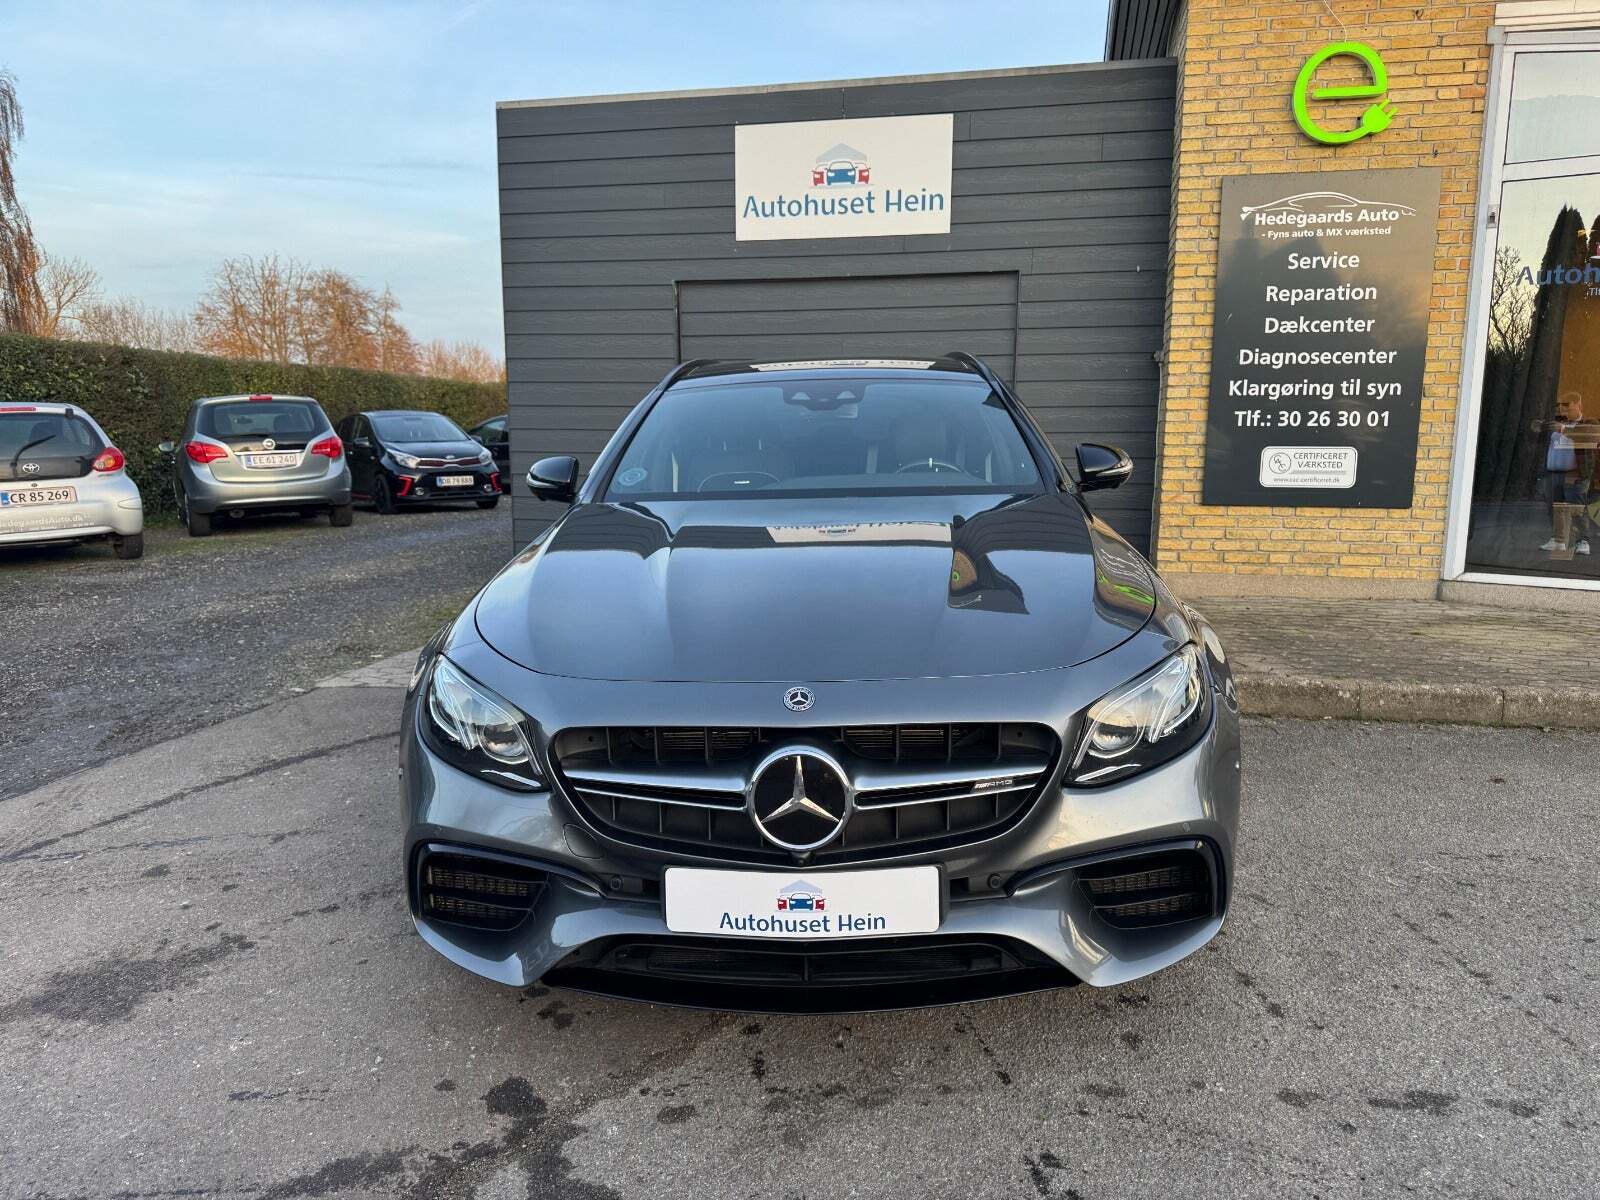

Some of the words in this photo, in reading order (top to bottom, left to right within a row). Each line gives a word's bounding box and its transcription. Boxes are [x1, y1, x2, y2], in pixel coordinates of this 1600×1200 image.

[743, 190, 875, 218] Autohuset
[885, 188, 944, 213] Hein
[1254, 209, 1353, 227] Hedegaards
[1357, 208, 1400, 222] Auto
[1267, 230, 1290, 240] Fyns
[1292, 229, 1314, 238] auto
[1316, 229, 1324, 237] &
[1326, 228, 1342, 237] MX
[1345, 226, 1392, 237] værksted
[1287, 251, 1360, 270] Service
[1265, 283, 1378, 306] Reparation
[1264, 316, 1376, 334] Dækcenter
[1238, 348, 1398, 370] Diagnosecenter
[1228, 379, 1334, 401] Klargøring
[1340, 378, 1361, 396] til
[1366, 381, 1402, 400] syn
[1234, 409, 1272, 427] Tlf.:
[1277, 410, 1301, 427] 30
[1306, 410, 1331, 427] 26
[1336, 410, 1361, 427] 30
[1366, 410, 1390, 427] 01
[252, 456, 265, 465] EE
[266, 455, 276, 464] 61
[1293, 452, 1349, 460] CERTIFICERET
[1297, 461, 1343, 469] VÆRKSTED
[10, 493, 27, 504] CR
[29, 491, 44, 502] 85
[47, 490, 69, 501] 269
[719, 912, 831, 933] Autohuset
[838, 912, 886, 931] Hein
